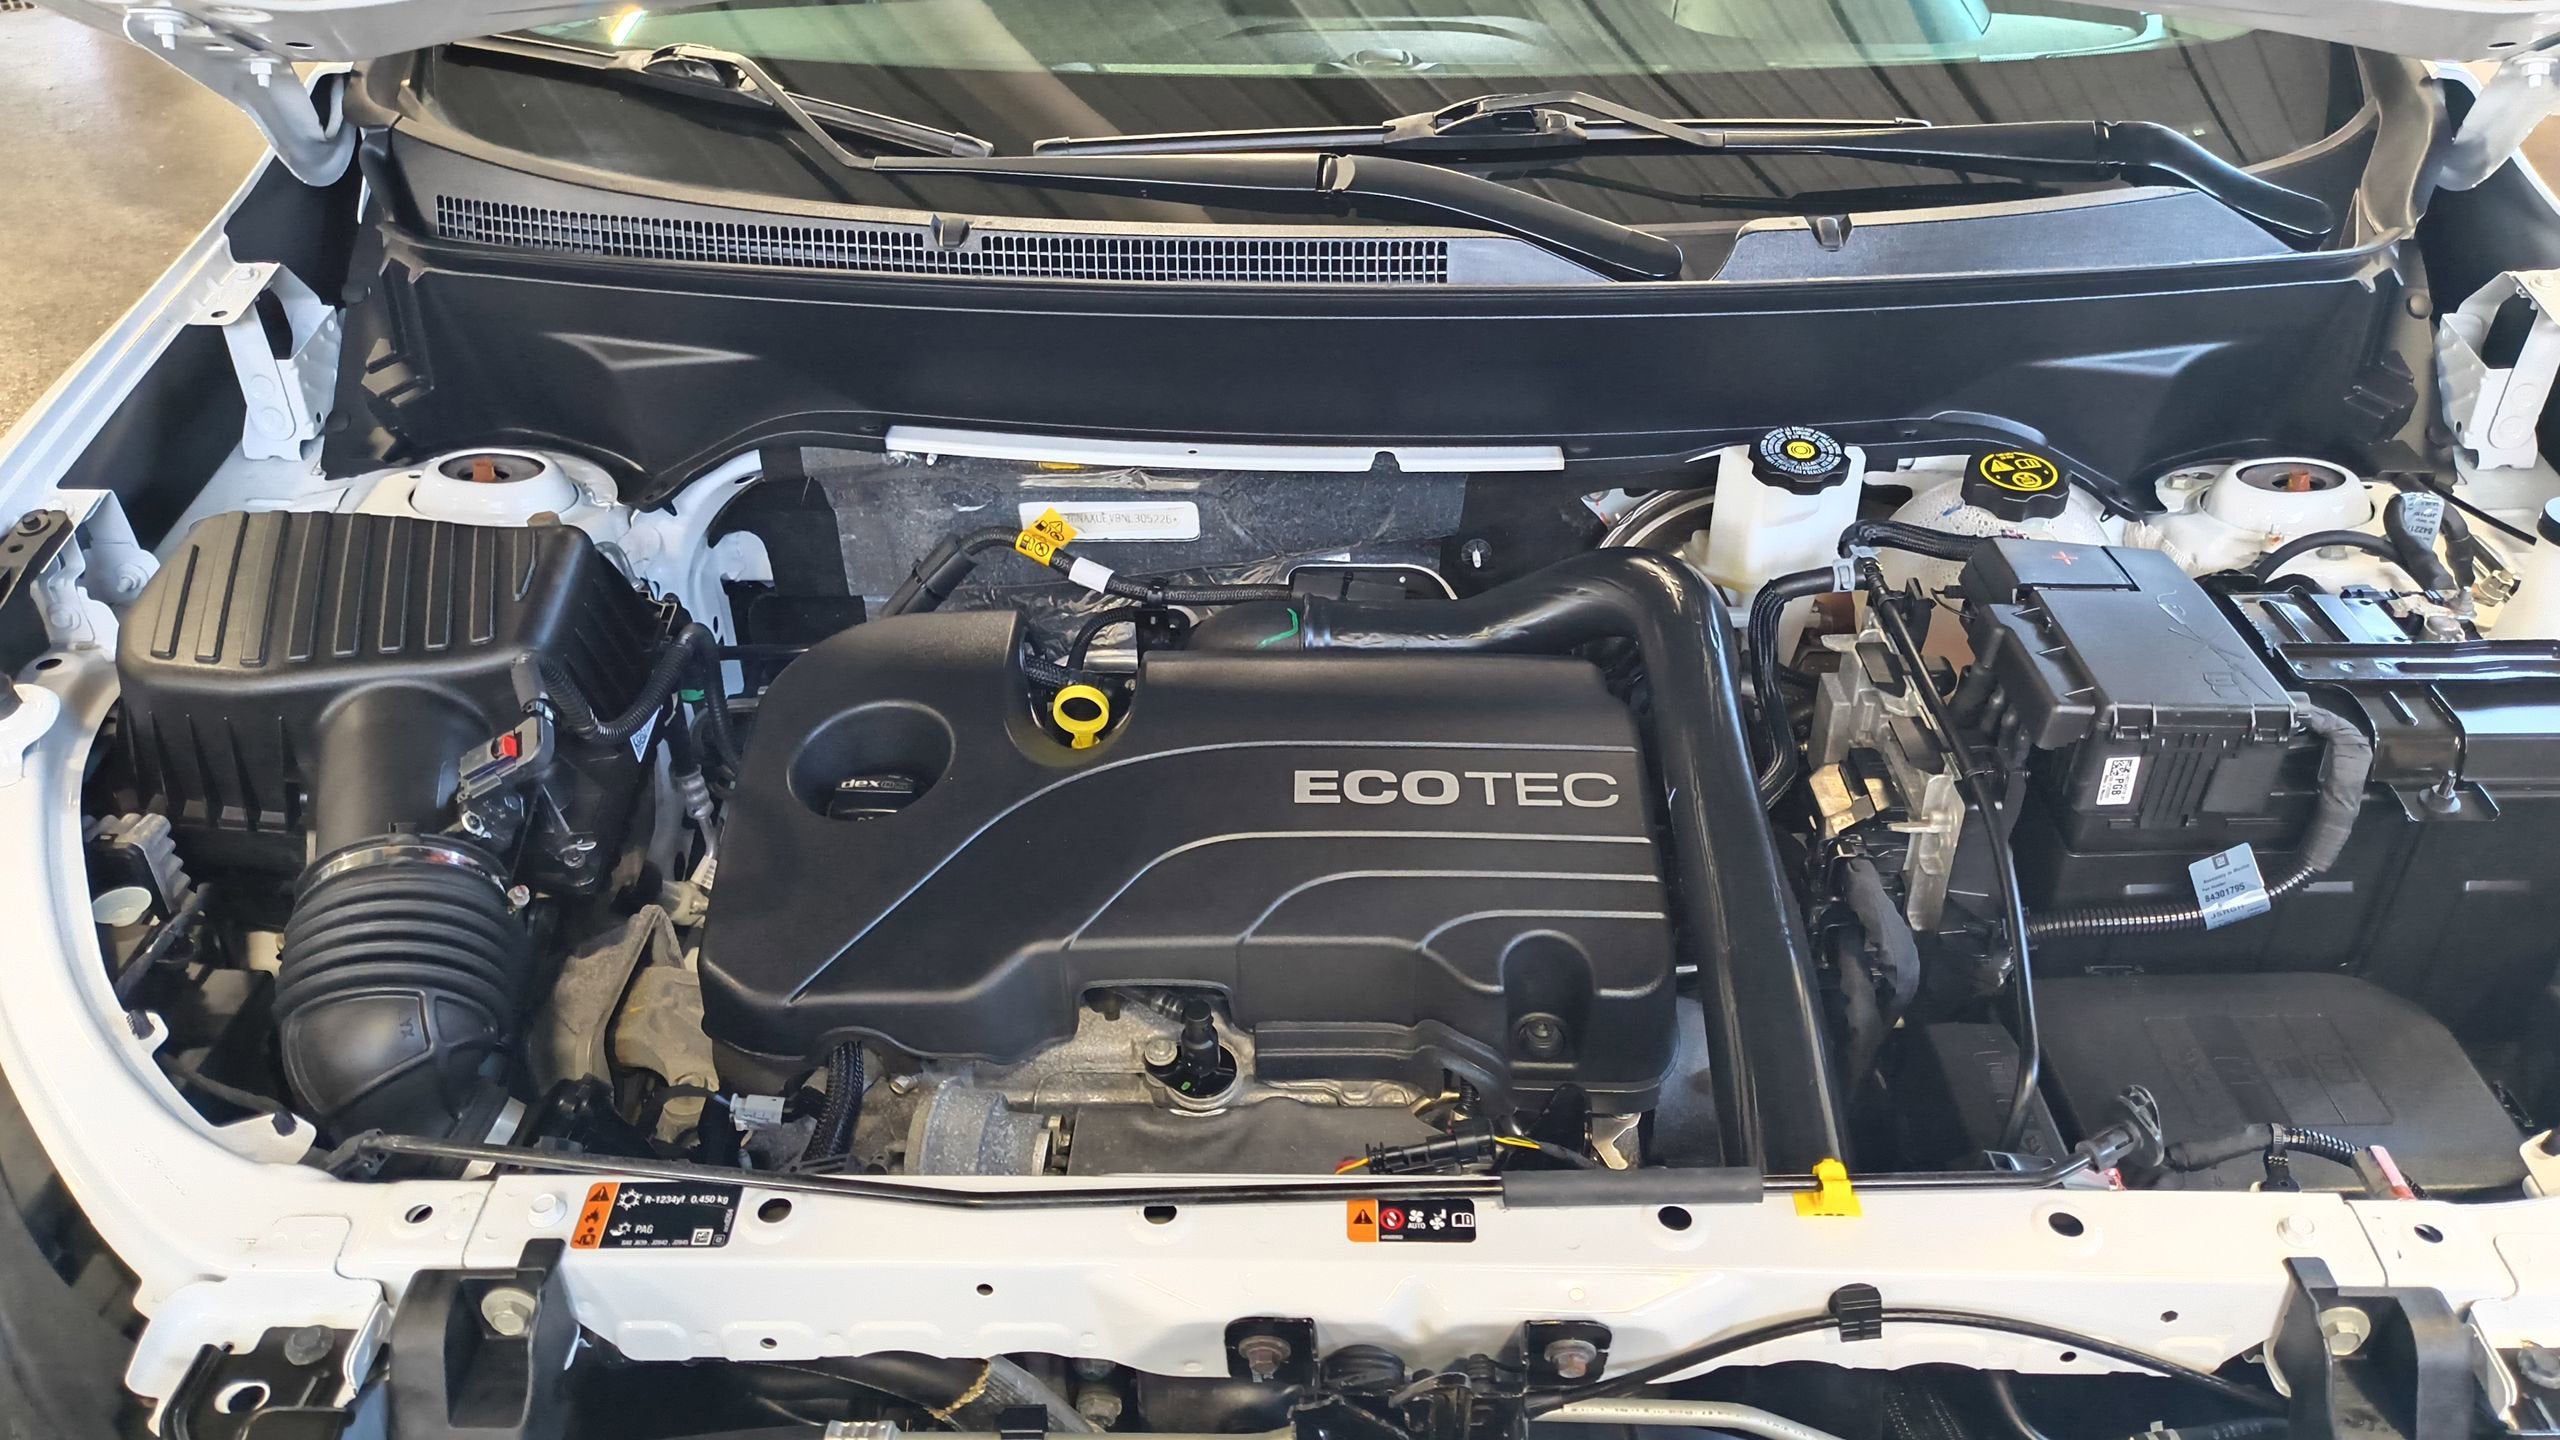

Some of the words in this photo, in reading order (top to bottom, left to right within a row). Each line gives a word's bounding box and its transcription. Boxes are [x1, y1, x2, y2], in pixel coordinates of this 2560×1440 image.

[1294, 769, 1619, 808] ECOTEC
[2204, 882, 2246, 902] 84301795
[644, 1194, 686, 1205] R-1234yf
[690, 1194, 716, 1204] 0.450
[717, 1195, 729, 1205] kg
[634, 1224, 654, 1234] PAG
[1407, 1222, 1426, 1230] AUTO
